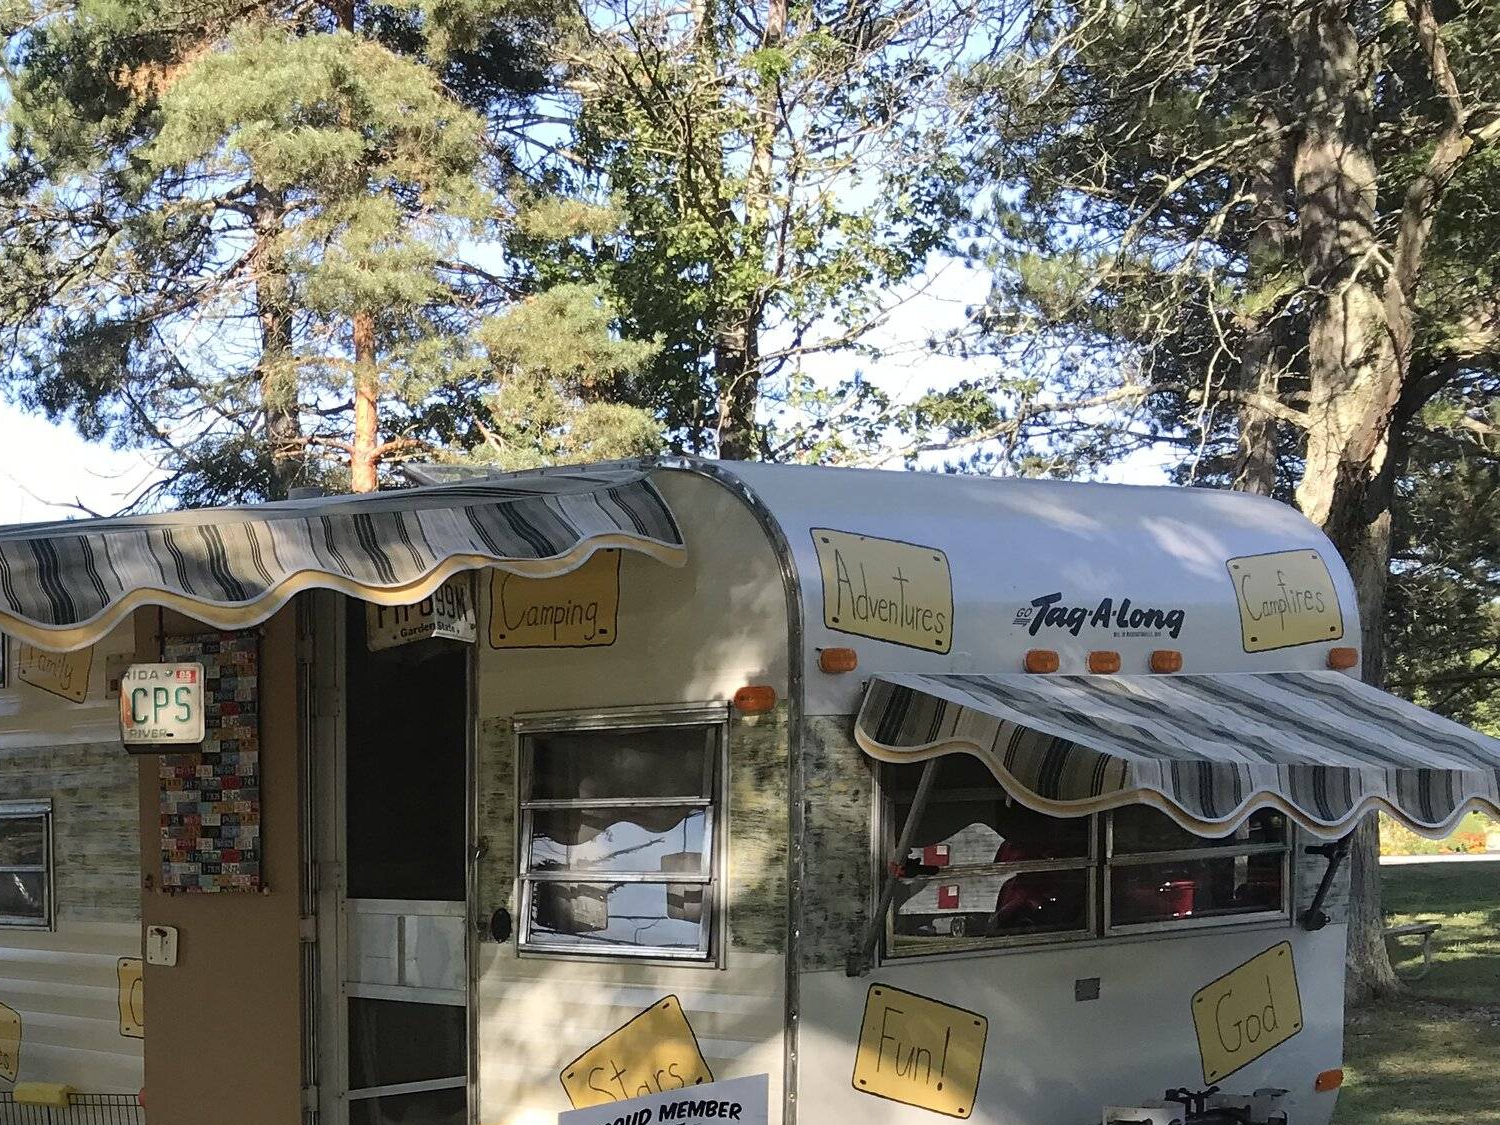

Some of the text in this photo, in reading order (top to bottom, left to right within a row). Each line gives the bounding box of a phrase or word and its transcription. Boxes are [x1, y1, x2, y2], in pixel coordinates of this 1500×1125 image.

[501, 572, 599, 642] Camping
[835, 548, 946, 634] Adventures
[1241, 568, 1325, 632] Campfires
[400, 622, 435, 638] Garden
[131, 686, 192, 725] CPS
[1215, 975, 1280, 1053] God
[876, 1006, 951, 1092] Fun!
[658, 1099, 743, 1122] MEMBER
